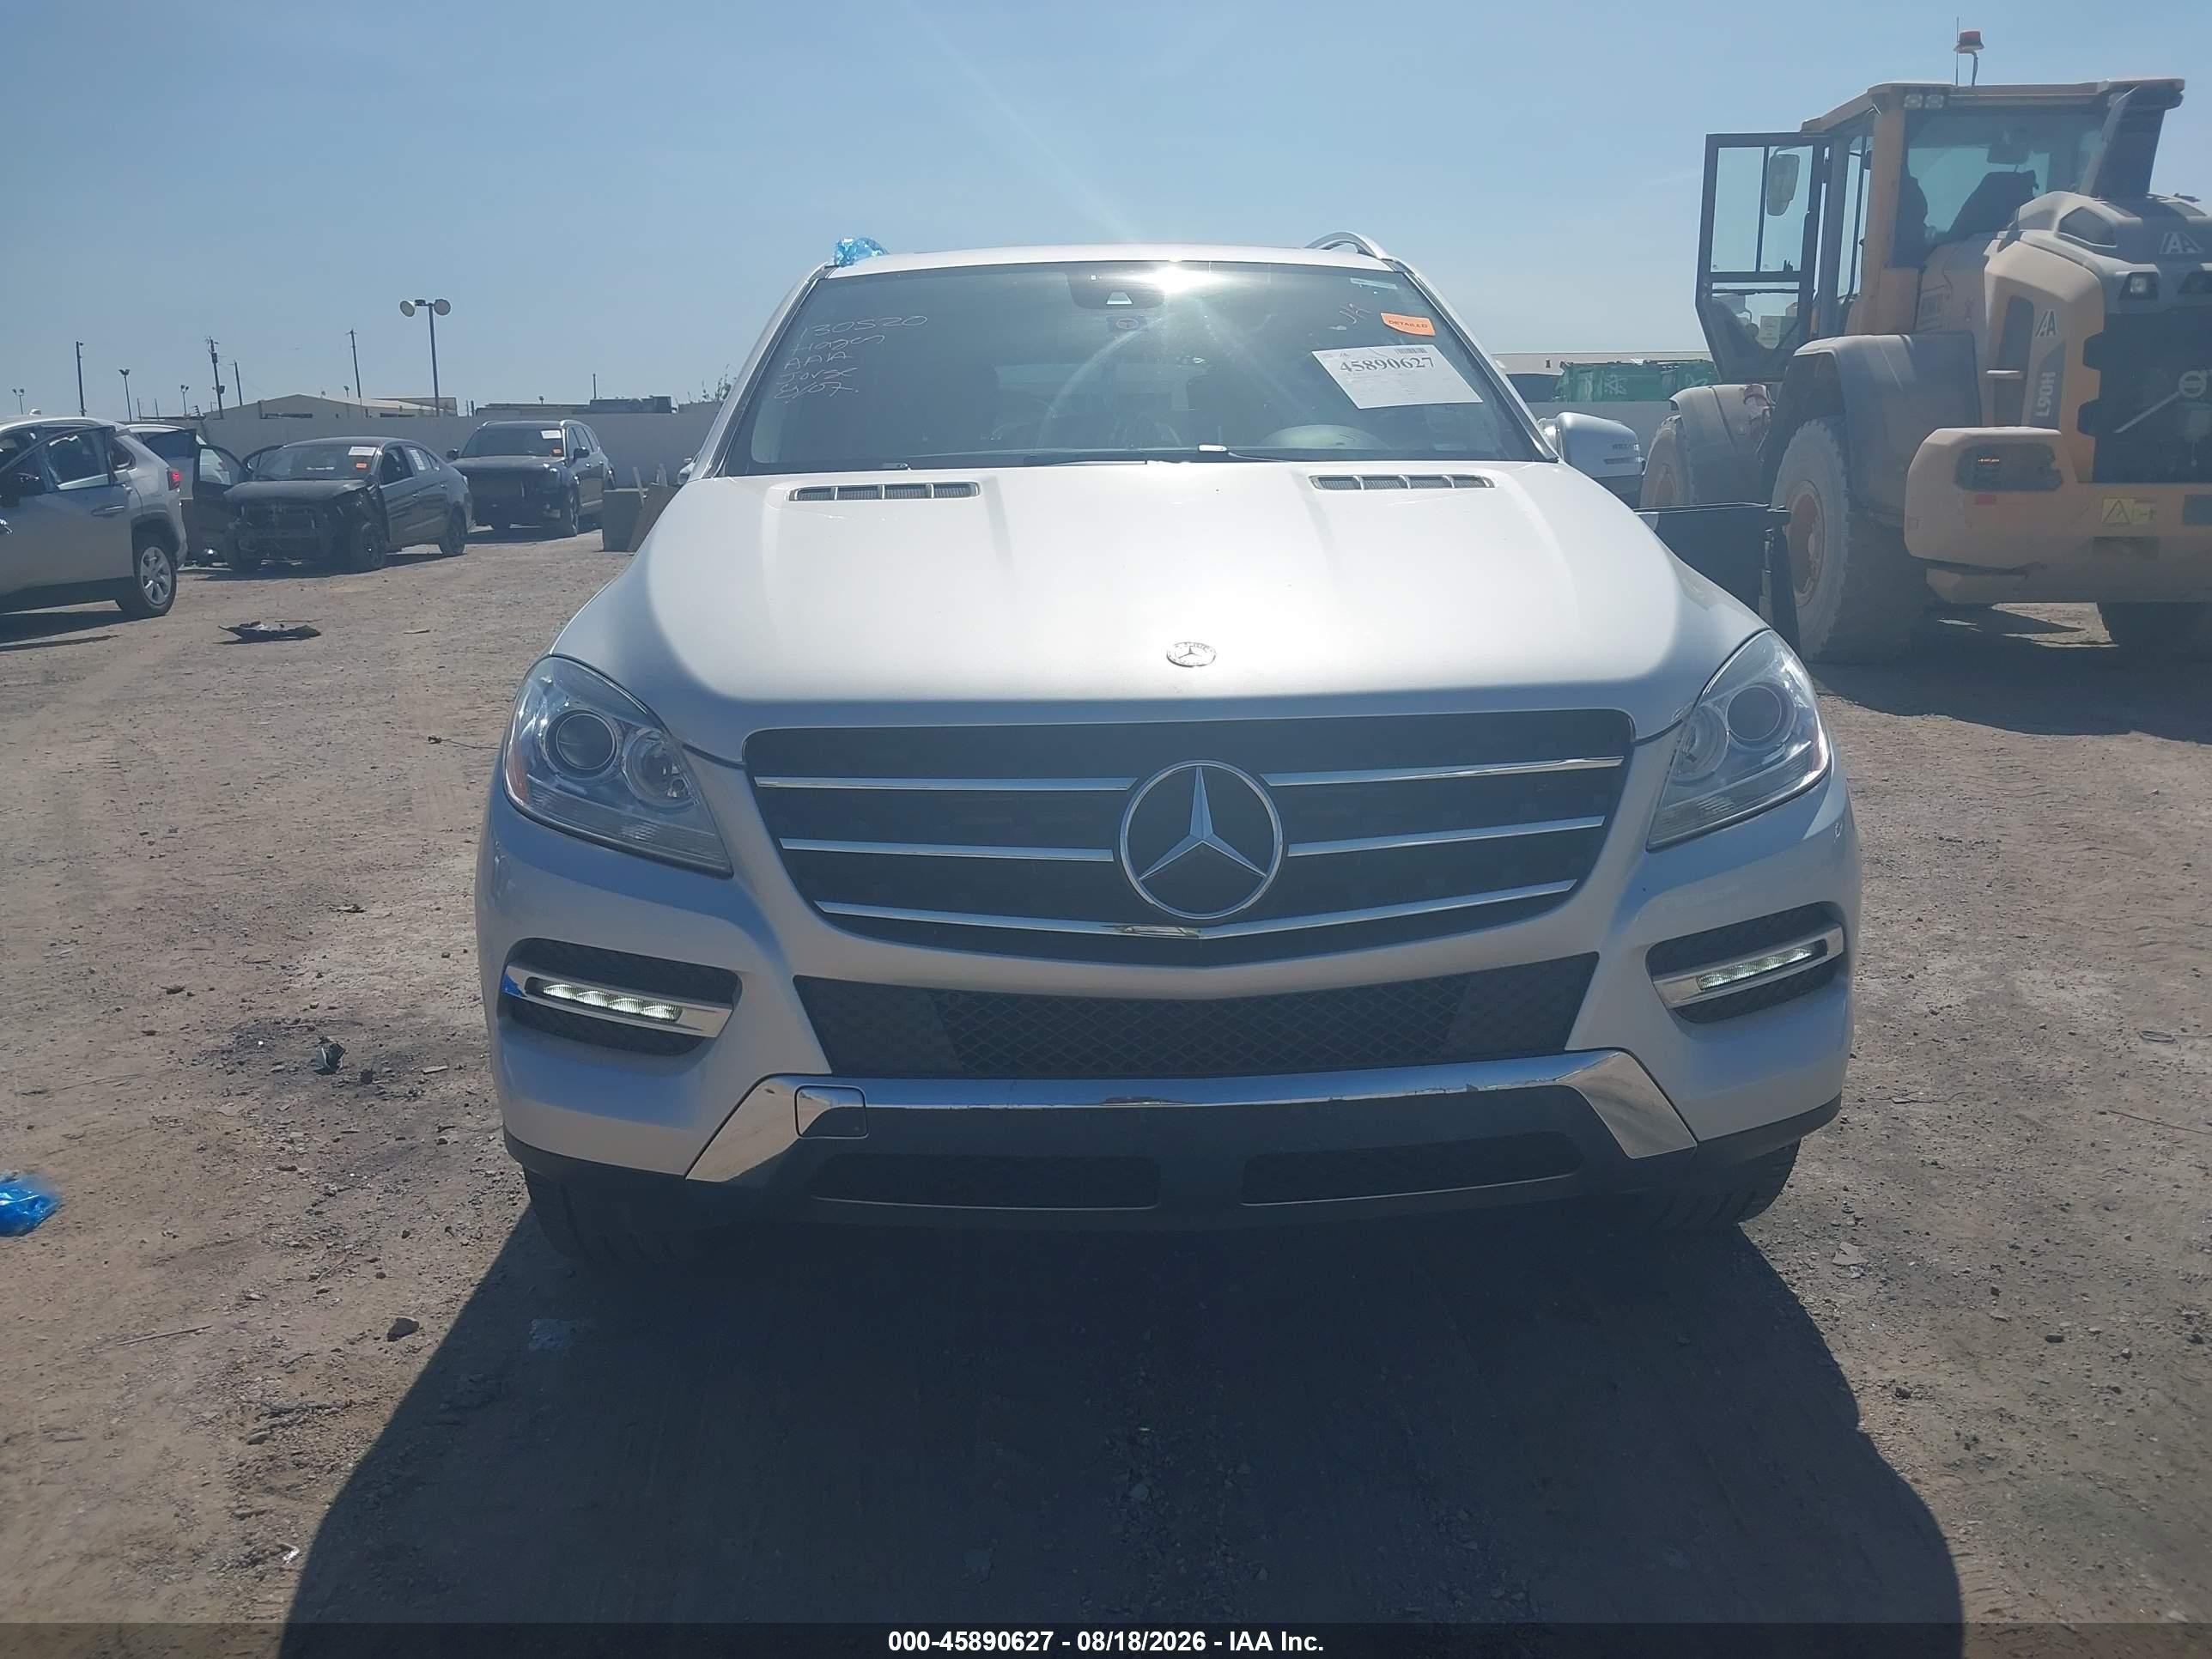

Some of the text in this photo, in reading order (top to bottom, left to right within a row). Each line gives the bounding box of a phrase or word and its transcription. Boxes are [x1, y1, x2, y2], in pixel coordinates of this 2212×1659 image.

[1388, 319, 1428, 329] DETAILED
[1339, 356, 1436, 374] 45890627
[2034, 371, 2057, 417] L90H
